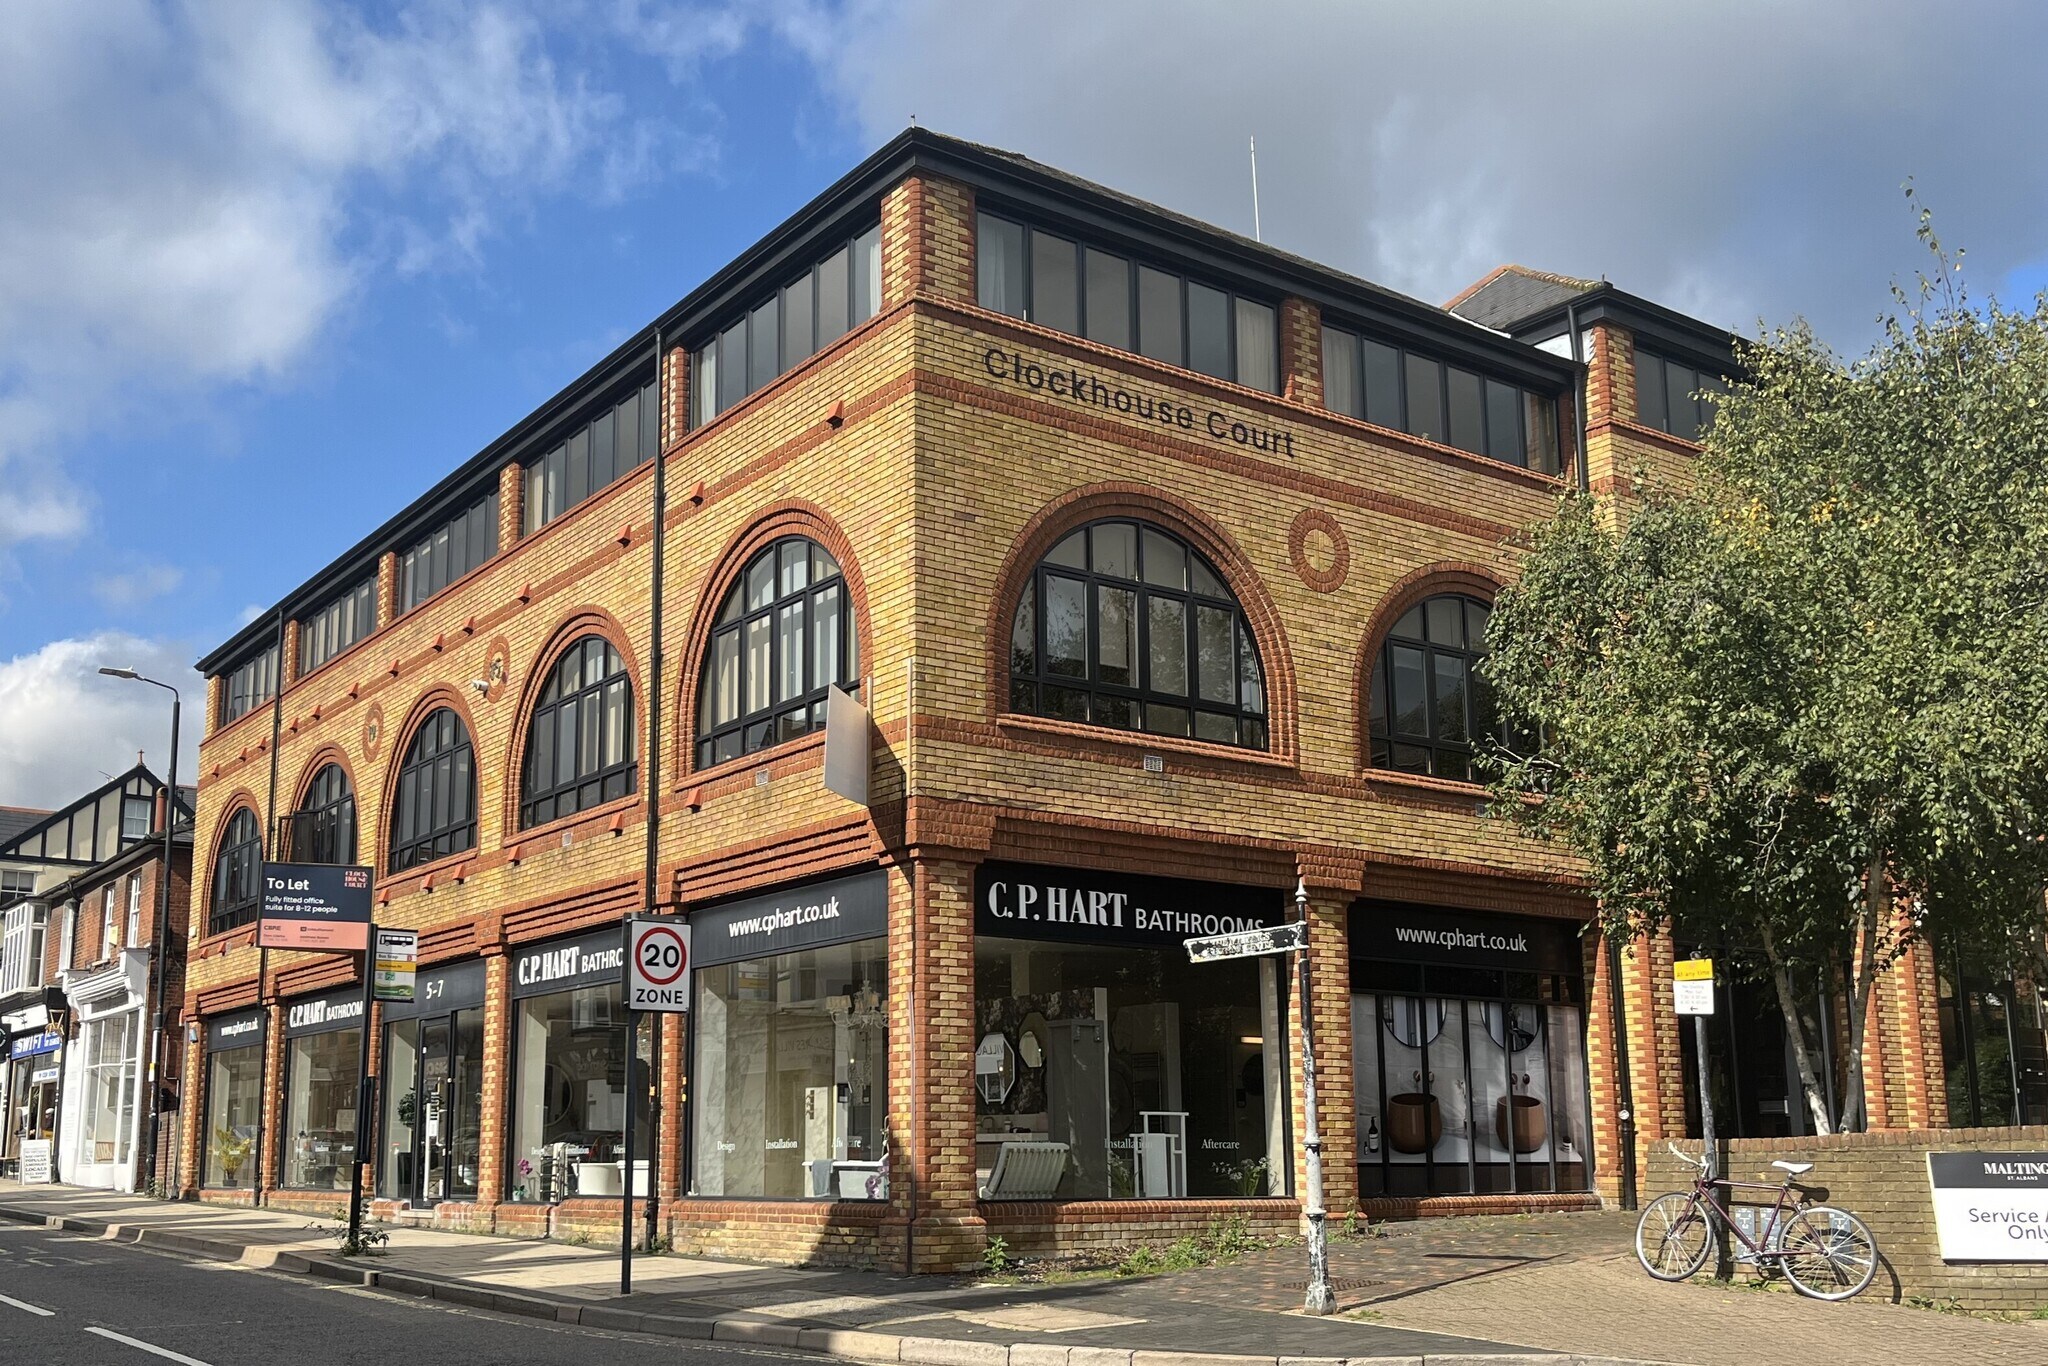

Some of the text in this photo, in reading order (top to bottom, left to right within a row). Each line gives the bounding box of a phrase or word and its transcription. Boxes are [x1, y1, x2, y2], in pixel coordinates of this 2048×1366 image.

[983, 349, 1295, 459] Clockhouse Court
[267, 878, 309, 890] To Let
[265, 896, 282, 904] Fully
[728, 895, 839, 937] www.cphart.co.uk
[1395, 927, 1528, 952] www.cphart.co.uk
[644, 944, 680, 968] 20
[426, 980, 444, 999] 5-7
[636, 989, 684, 1004] ZONE
[326, 1001, 363, 1021] BATHROOM
[221, 1017, 258, 1036] www.cphart.co.uk
[16, 1034, 43, 1053] SWIFT
[717, 1140, 735, 1153] Design
[765, 1138, 798, 1150] Installation
[1201, 1138, 1240, 1150] Aftercare
[1984, 1162, 2048, 1174] MALTING
[1969, 1208, 2039, 1222] Service
